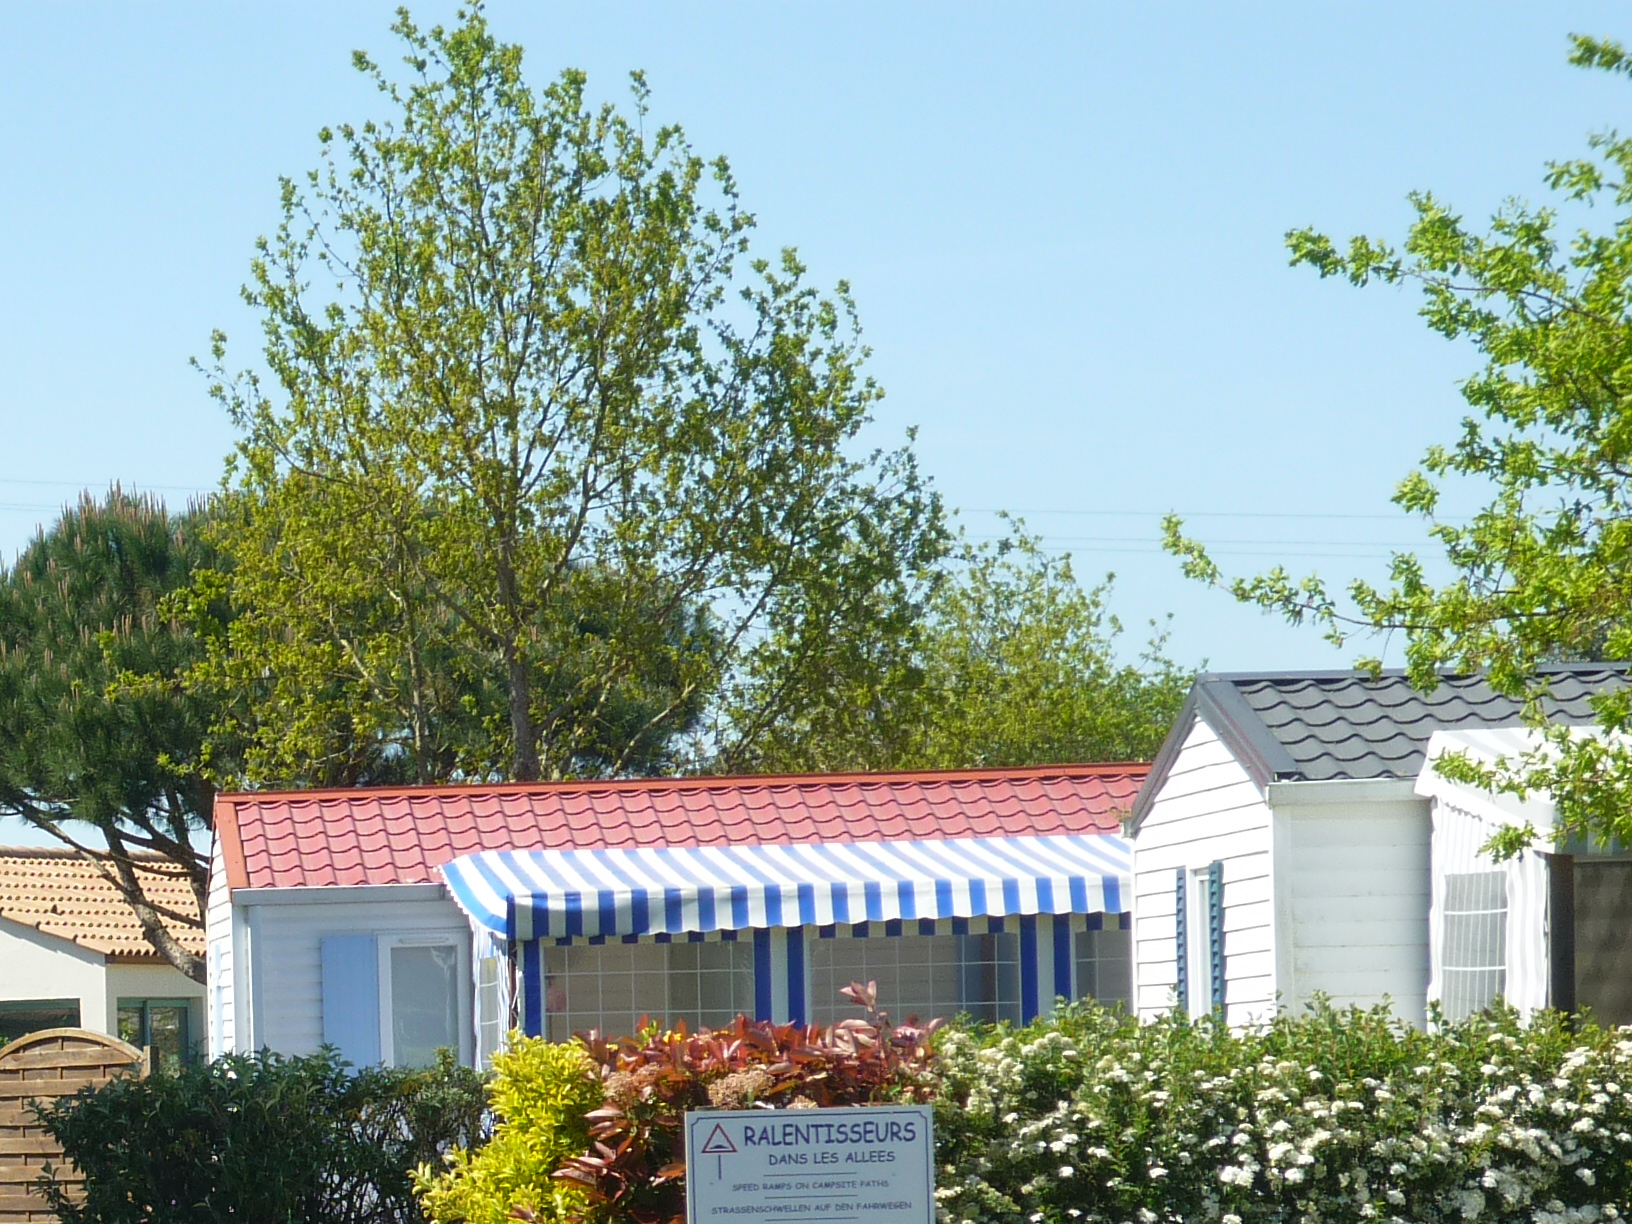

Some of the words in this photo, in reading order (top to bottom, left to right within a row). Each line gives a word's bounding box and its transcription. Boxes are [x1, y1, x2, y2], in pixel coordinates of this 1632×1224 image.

[744, 1121, 917, 1146] RALENTISSEURS
[768, 1153, 808, 1166] DANS
[814, 1152, 839, 1164] LES
[845, 1150, 896, 1163] ALLEES
[732, 1183, 760, 1192] SPEED
[762, 1182, 792, 1190] RAMPS
[795, 1182, 809, 1190] ON
[812, 1180, 857, 1189] CAMPSITE
[860, 1180, 890, 1188] PATHS
[711, 1204, 811, 1215] STRASSENSCHWELLEN
[814, 1203, 831, 1212] AUF
[835, 1203, 853, 1211] DEN
[856, 1201, 912, 1210] FAHRWEGEN
